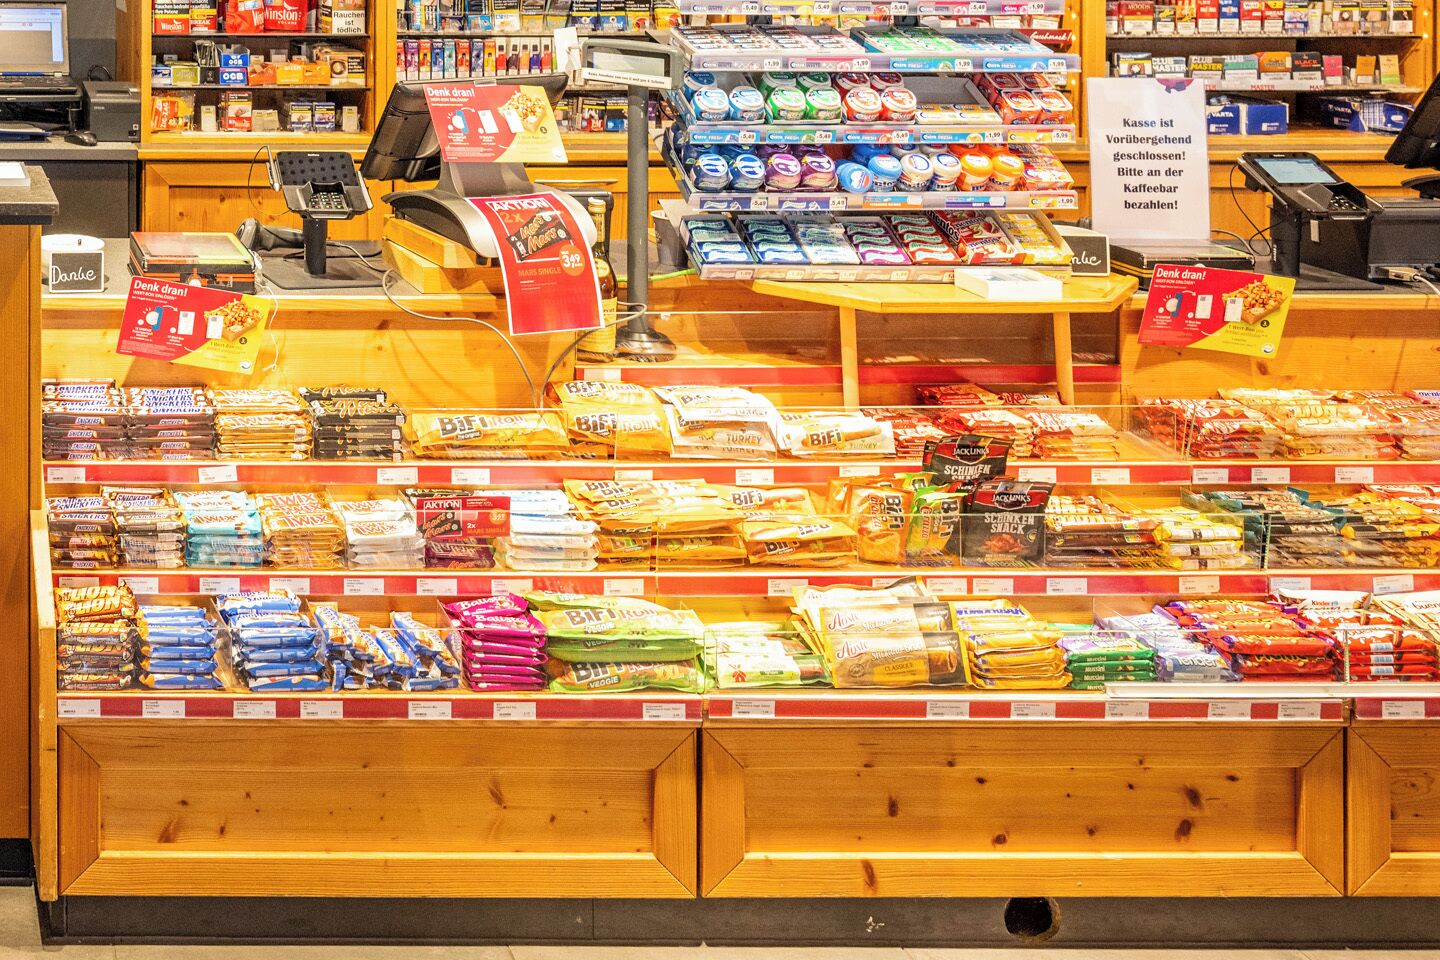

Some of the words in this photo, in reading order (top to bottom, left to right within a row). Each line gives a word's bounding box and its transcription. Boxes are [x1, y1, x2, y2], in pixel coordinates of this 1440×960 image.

[1152, 64, 1186, 72] MASTER
[1191, 63, 1222, 71] MASTER
[427, 87, 450, 97] Denk
[452, 87, 476, 97] dran!
[1123, 118, 1156, 128] Kasse
[1160, 118, 1174, 128] ist
[1106, 134, 1192, 147] Vorübergehend
[1113, 151, 1186, 162] geschlossen!
[1117, 167, 1143, 178] Bitte
[1147, 170, 1161, 178] an
[1164, 167, 1184, 178] der
[1124, 183, 1178, 194] Kaffeebar
[492, 198, 549, 211] AKTION
[1124, 199, 1178, 210] bezahlen!
[51, 265, 96, 284] Danke
[518, 268, 538, 277] MARS
[538, 267, 562, 276] SINGLE
[1156, 268, 1180, 279] Denk
[1182, 270, 1207, 281] dran!
[134, 279, 160, 292] Denk
[161, 283, 188, 297] dran!
[437, 415, 488, 436] BiFi
[575, 413, 617, 432] BiFi
[726, 433, 762, 445] TURKEY
[809, 429, 842, 449] BiFi
[953, 447, 970, 456] JACK
[944, 464, 991, 476] SCHINKEN
[425, 500, 460, 509] AKTION
[732, 491, 763, 506] BiFi
[991, 494, 1008, 502] JACK
[1008, 494, 1031, 503] LINK'S
[984, 512, 1035, 525] SCHINKEN
[990, 522, 1026, 535] SNACK
[460, 595, 505, 610] Balisto
[475, 613, 521, 624] Balisto
[564, 607, 616, 626] BiFi
[584, 622, 615, 634] VEGGIE
[588, 676, 620, 688] VEGGIE
